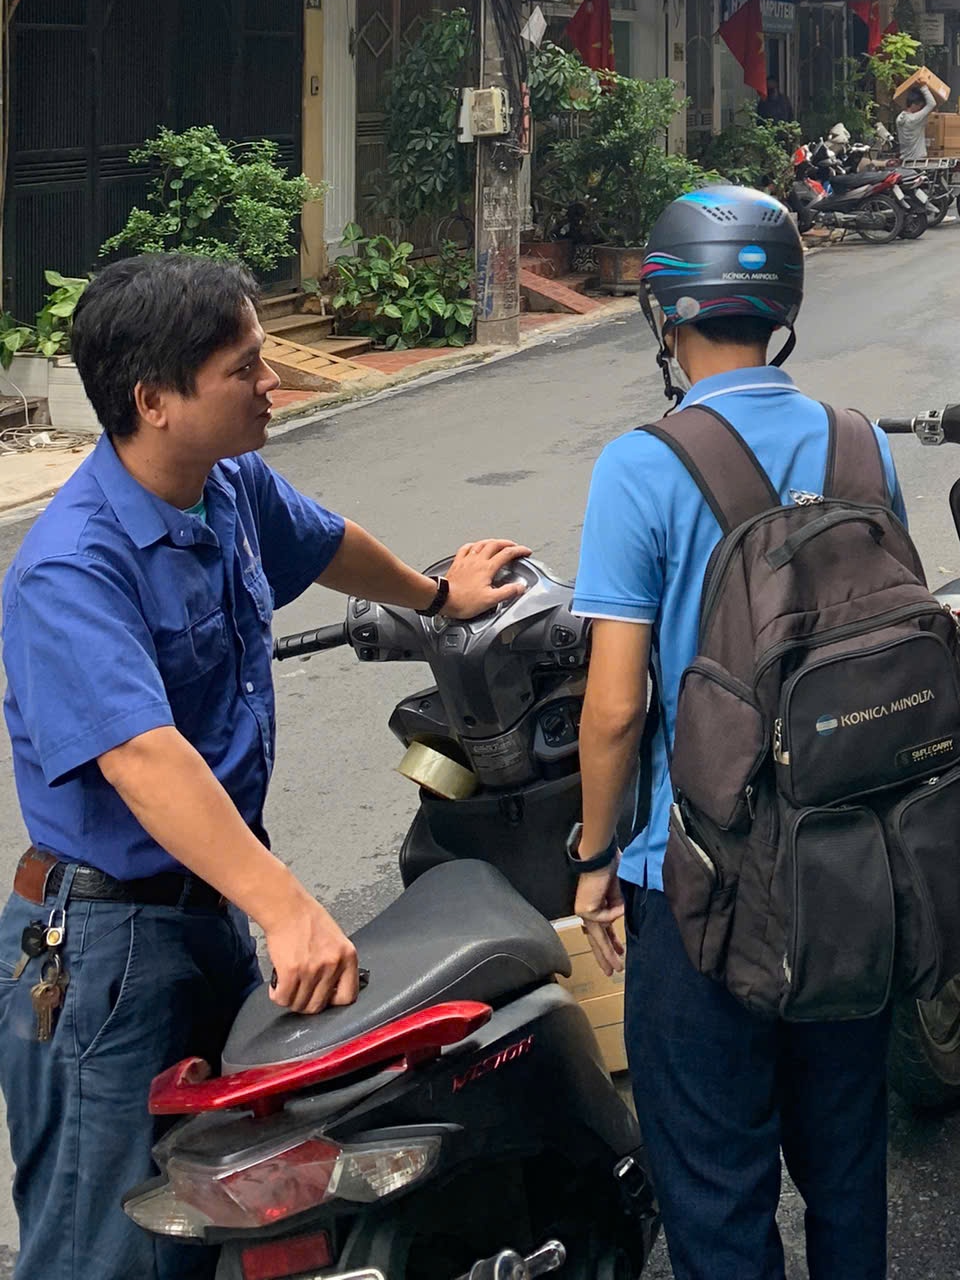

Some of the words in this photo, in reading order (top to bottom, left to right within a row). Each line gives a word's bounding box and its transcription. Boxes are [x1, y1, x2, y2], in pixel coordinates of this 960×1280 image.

[722, 272, 750, 281] KONICA
[751, 272, 779, 281] MINOLTA
[840, 705, 889, 727] KONICA
[890, 689, 936, 713] MINOLTA
